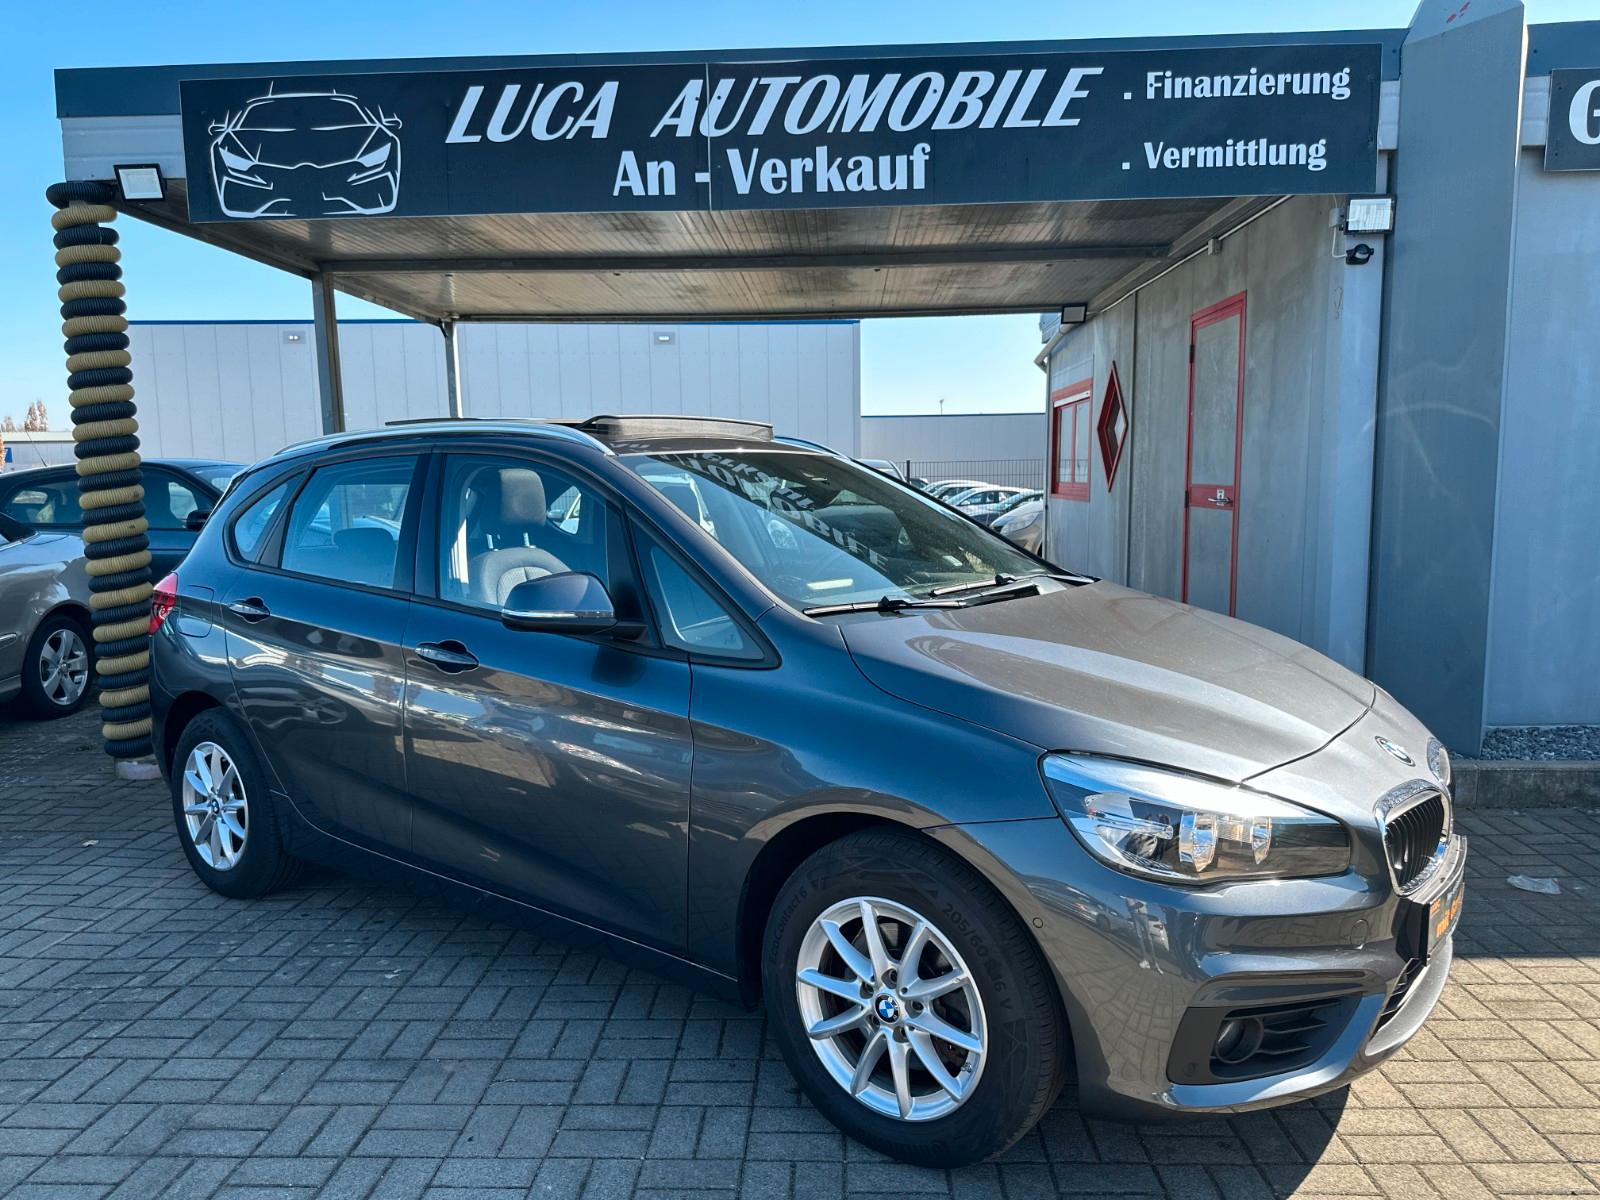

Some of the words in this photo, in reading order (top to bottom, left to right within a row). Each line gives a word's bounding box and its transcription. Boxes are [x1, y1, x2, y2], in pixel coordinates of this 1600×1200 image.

[445, 81, 620, 144] LUCA
[650, 67, 1105, 138] AUTOMOBILE
[1145, 67, 1352, 101] Finanzierung
[612, 150, 677, 198] An
[727, 142, 931, 195] Verkauf
[1144, 136, 1328, 172] Vermittlung
[943, 903, 989, 957] 205/60
